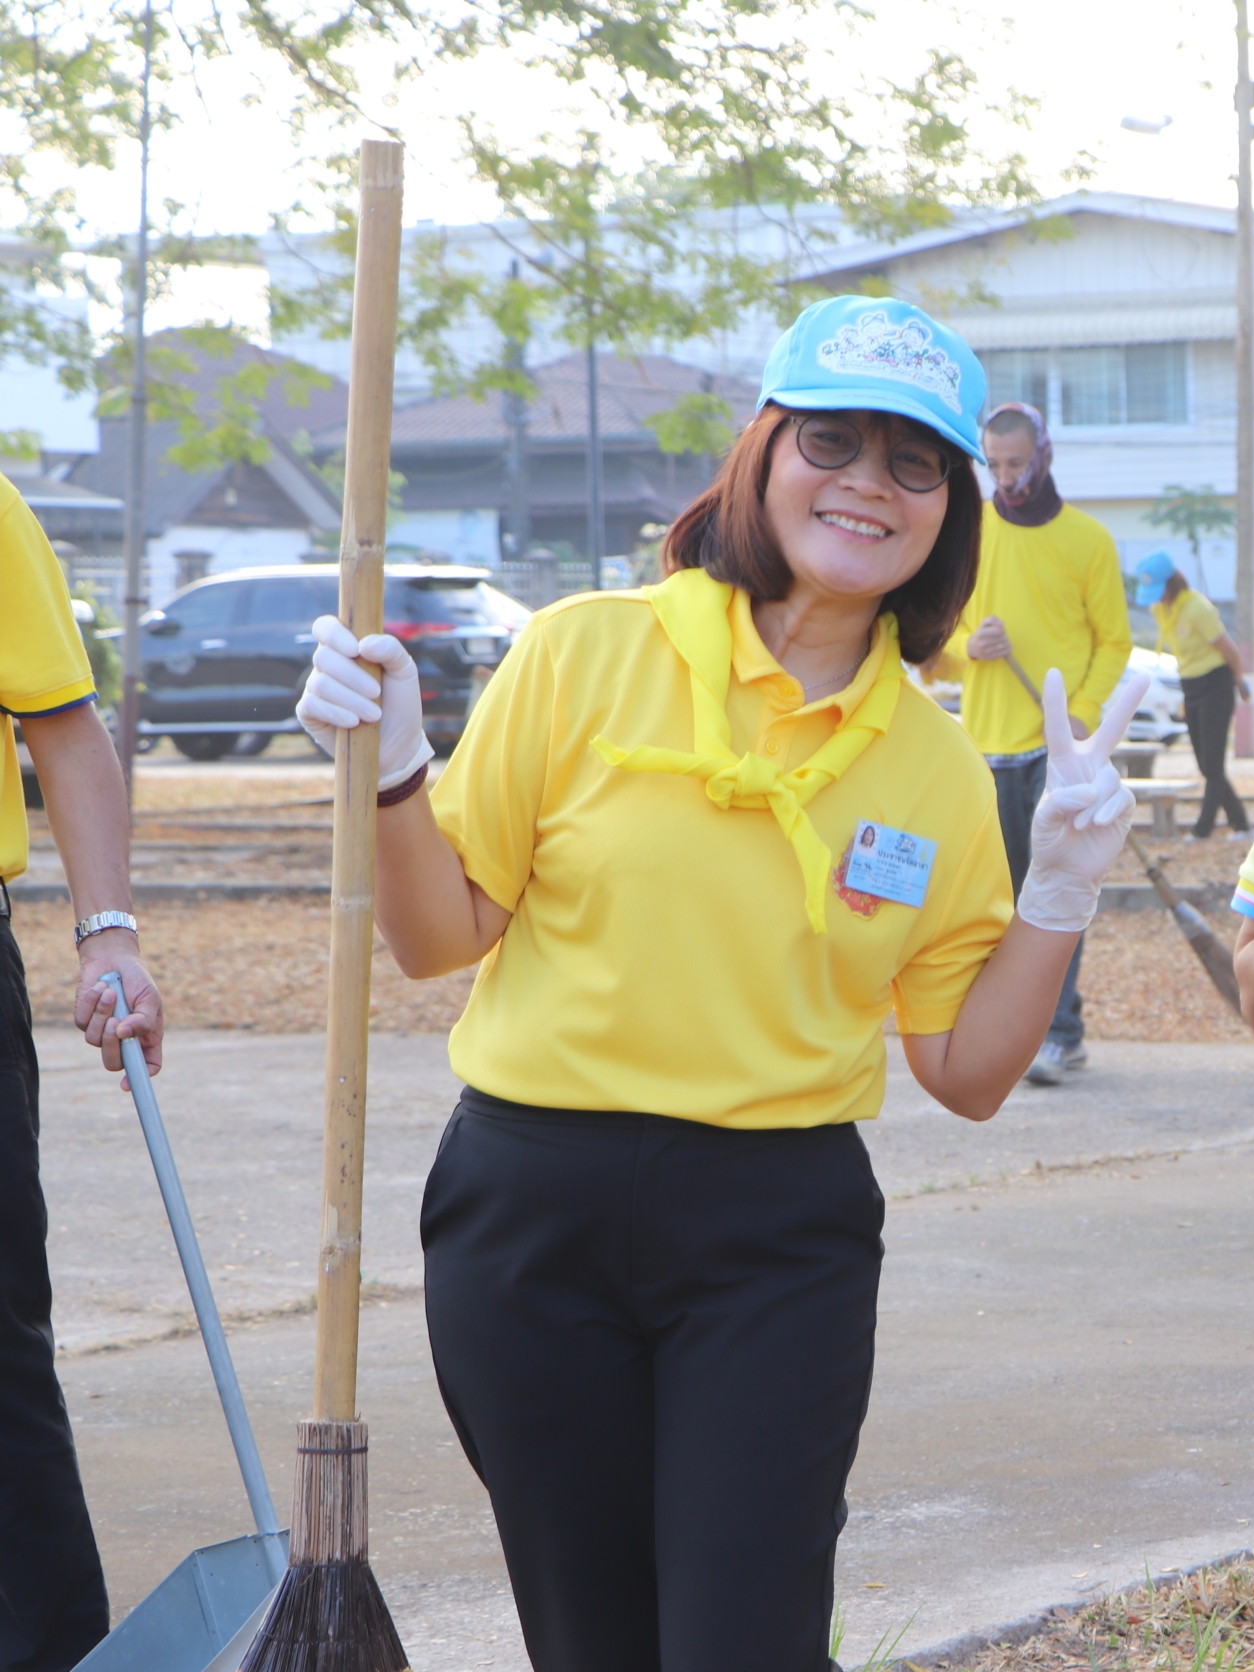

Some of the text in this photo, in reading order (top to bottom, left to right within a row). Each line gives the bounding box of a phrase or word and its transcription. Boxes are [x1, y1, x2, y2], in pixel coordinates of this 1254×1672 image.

[877, 850, 929, 871] ประชาชนจิตอาสา
